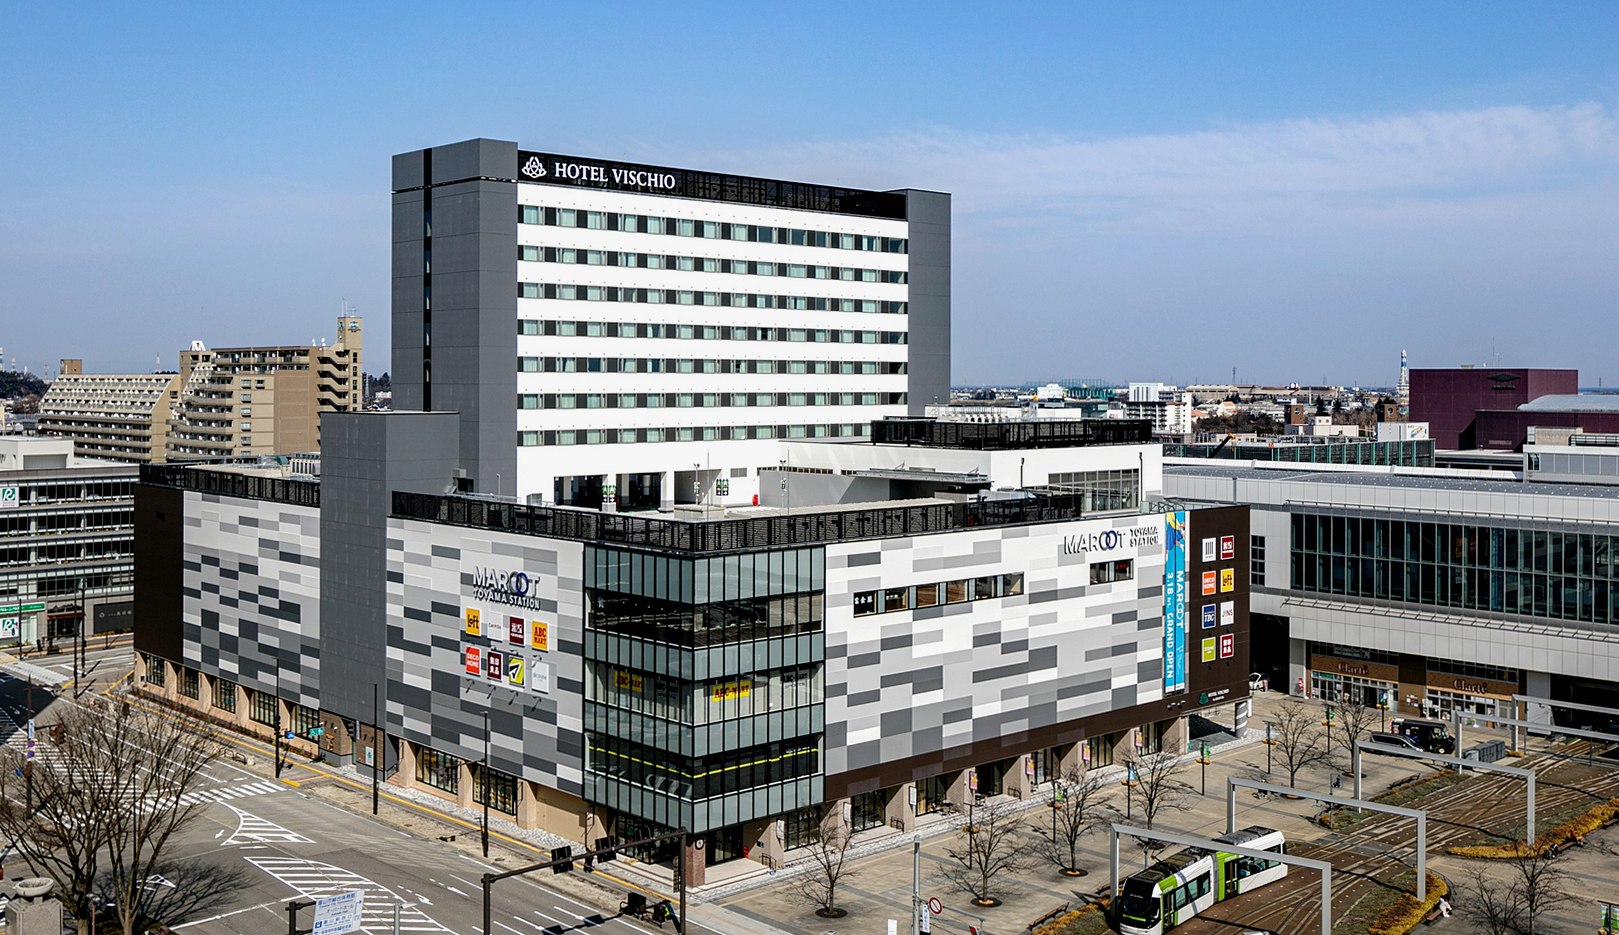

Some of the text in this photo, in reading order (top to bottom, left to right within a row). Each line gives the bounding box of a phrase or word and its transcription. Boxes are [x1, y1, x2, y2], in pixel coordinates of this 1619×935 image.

[554, 162, 676, 189] HOTEL VISCHIO
[1063, 530, 1126, 555] MAROOT
[1129, 526, 1158, 538] TOYAMA
[1129, 535, 1158, 548] STATION
[473, 566, 541, 597] MAROOT
[473, 588, 541, 610] TOYAMA STATION
[1176, 570, 1184, 629] MAROOT
[534, 626, 547, 638] ABC
[534, 636, 547, 646] MART
[1166, 613, 1174, 648] GRAND
[1166, 653, 1174, 679] OPEN
